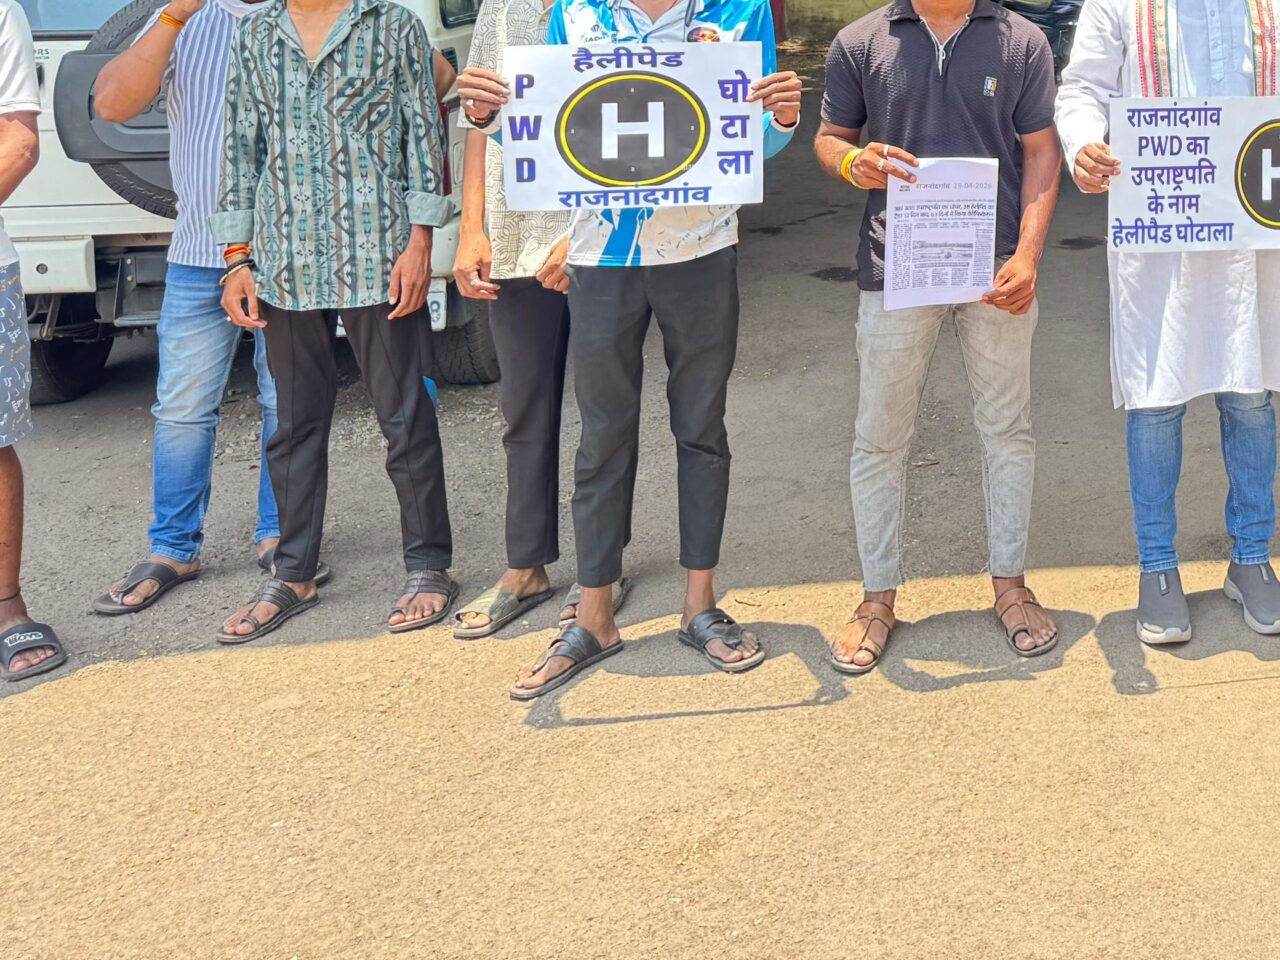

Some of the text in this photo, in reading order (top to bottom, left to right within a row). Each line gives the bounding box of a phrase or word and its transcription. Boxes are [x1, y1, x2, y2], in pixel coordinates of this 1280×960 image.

[572, 46, 685, 72] हैलीपेड
[1127, 101, 1222, 128] राजनांदगांव
[601, 101, 665, 159] H
[1138, 136, 1210, 157] PWD का
[1131, 158, 1217, 190] उपराष्ट्रपति
[558, 183, 712, 207] राजनांदगांव
[1147, 189, 1200, 214] के नाम
[1112, 216, 1234, 247] हेलीपैड घोटाला
